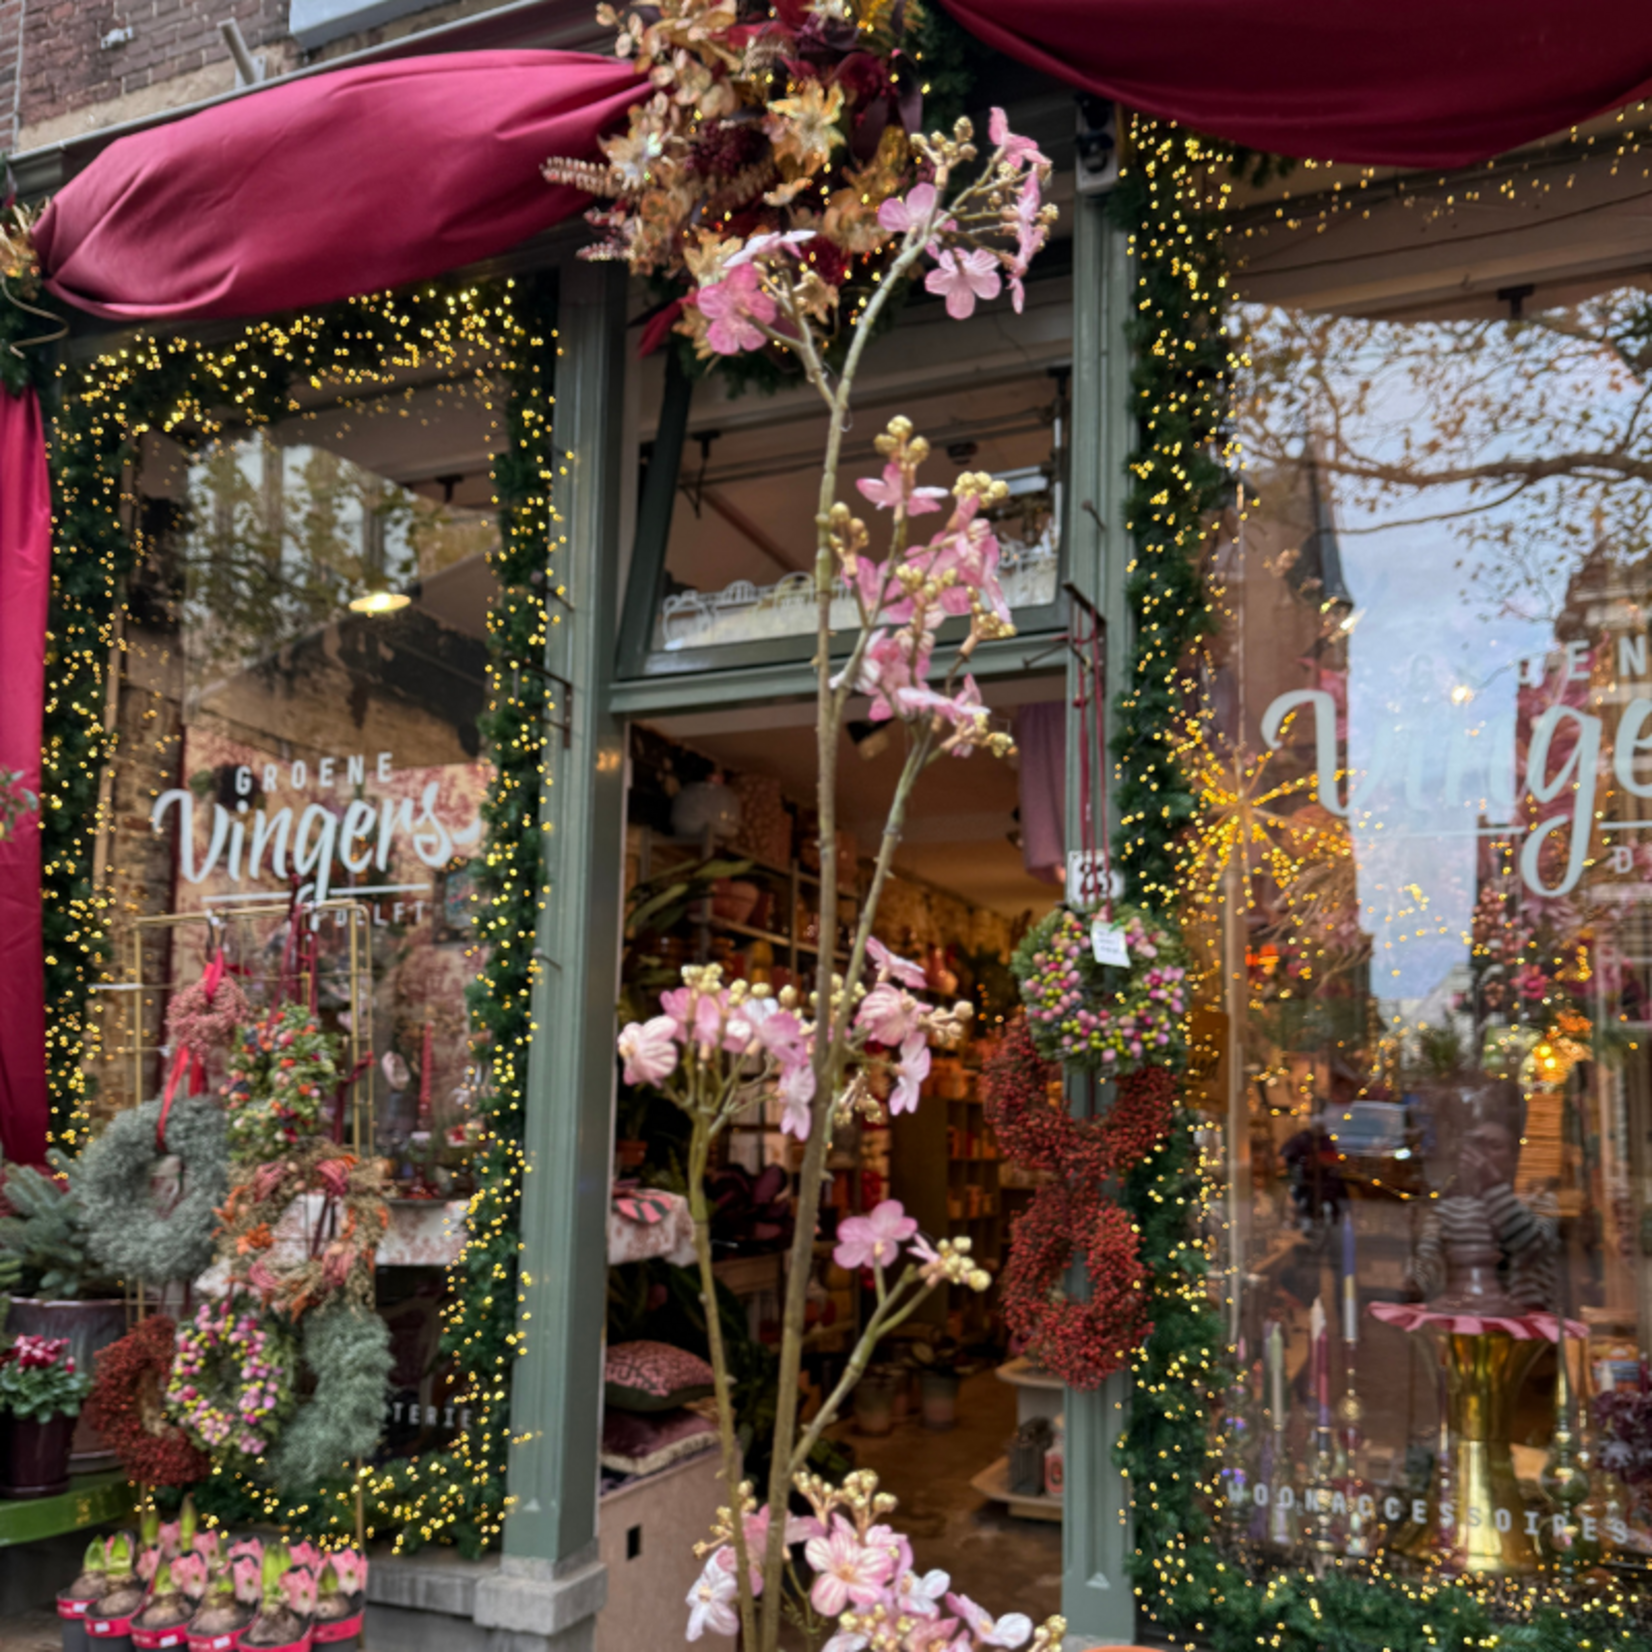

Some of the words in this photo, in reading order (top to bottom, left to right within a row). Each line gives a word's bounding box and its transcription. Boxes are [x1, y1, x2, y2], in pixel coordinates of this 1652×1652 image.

[235, 752, 394, 796] GROENE
[151, 781, 482, 932] Vingers
[1227, 1480, 1629, 1545] WOONACCESSOIRES
